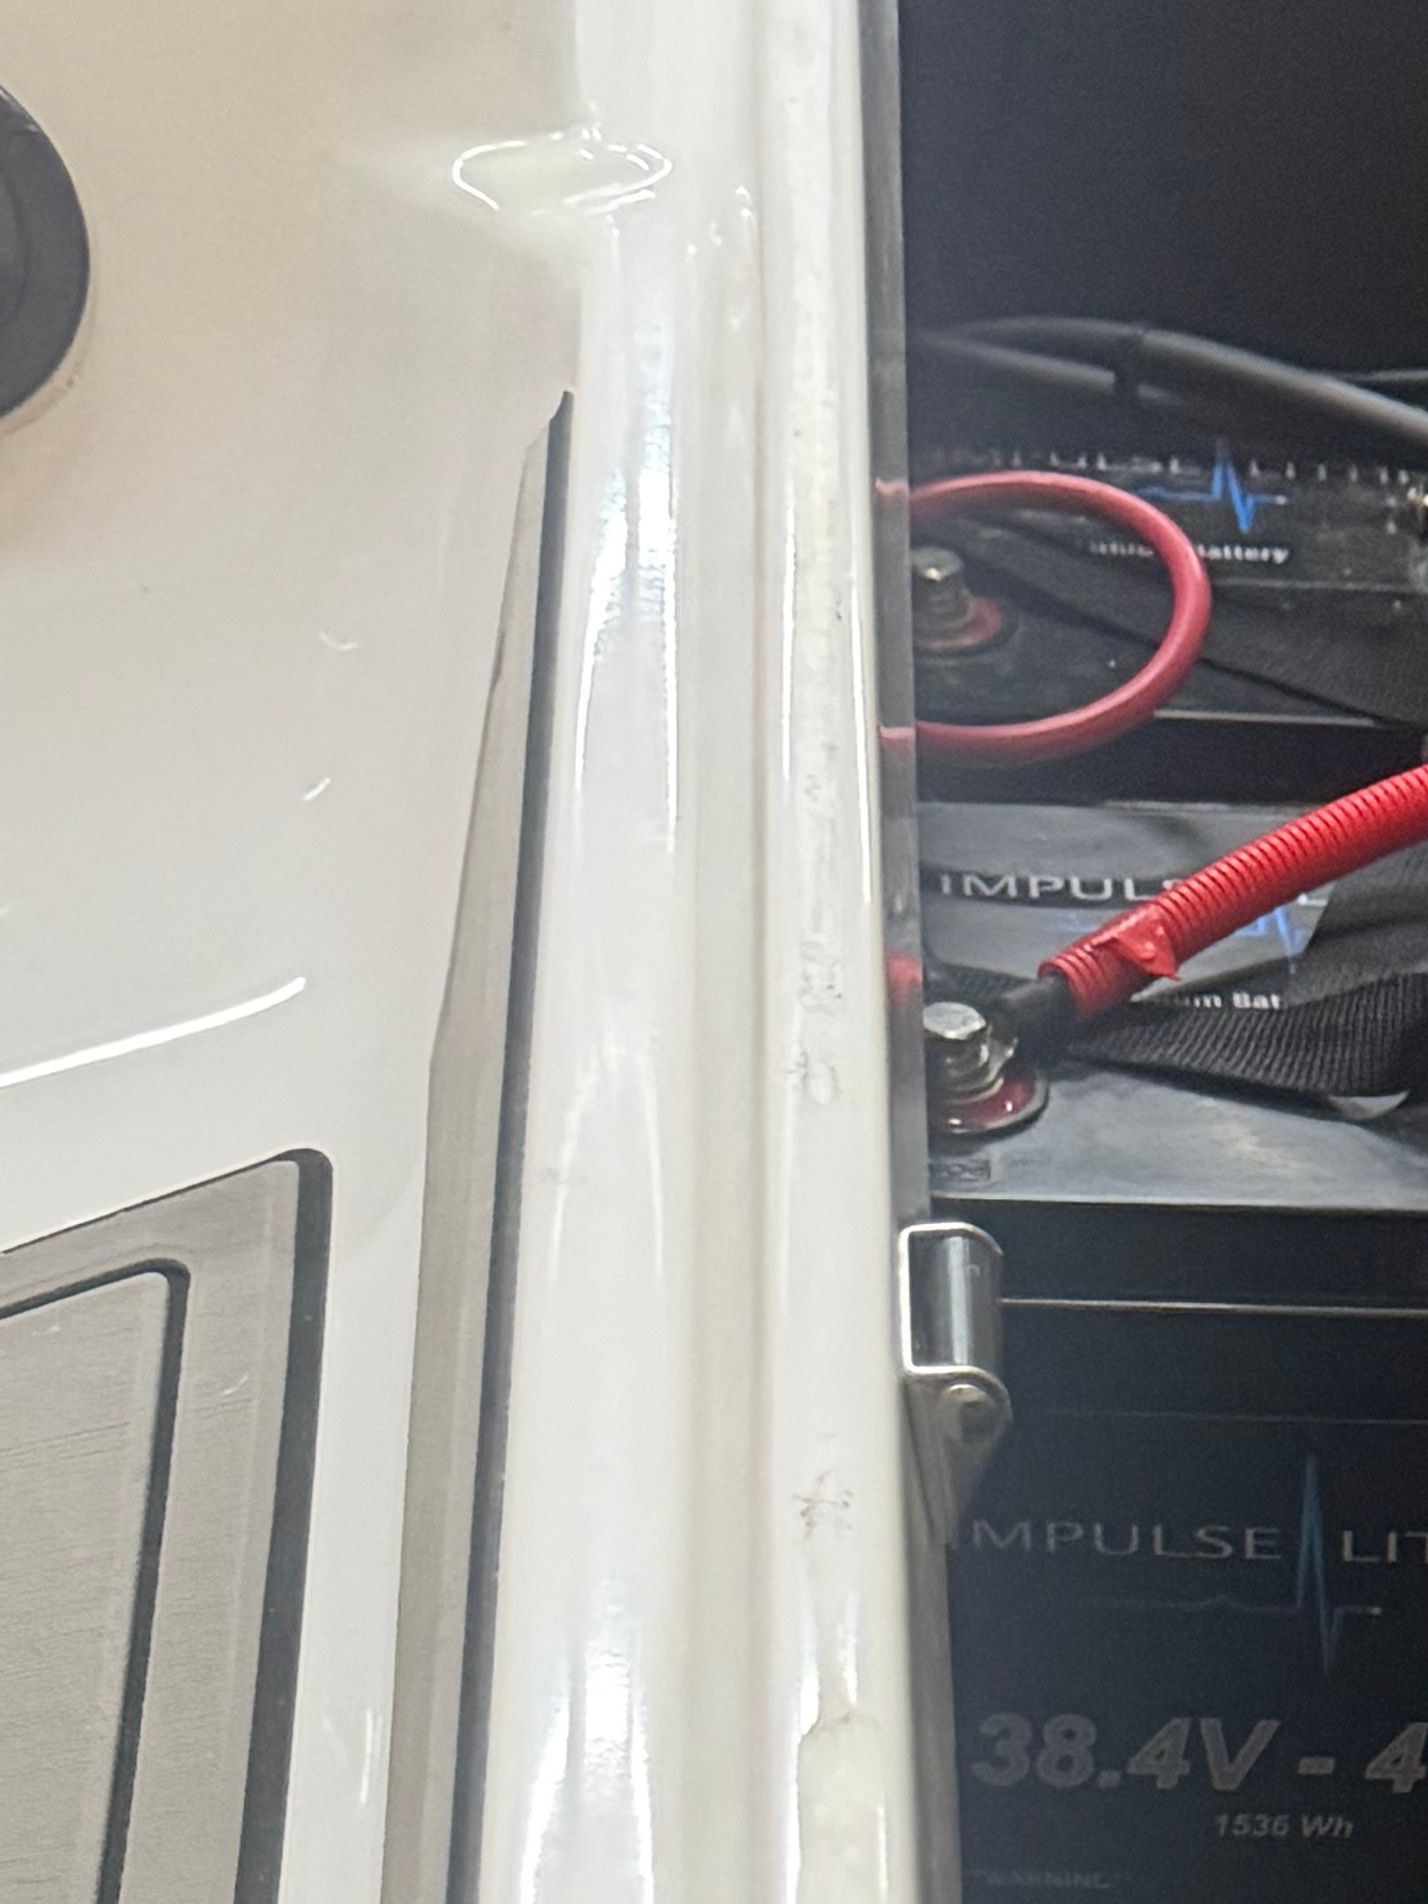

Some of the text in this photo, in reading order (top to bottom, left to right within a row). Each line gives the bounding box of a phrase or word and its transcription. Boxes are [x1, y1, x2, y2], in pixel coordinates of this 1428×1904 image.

[938, 873, 1183, 902] IMPUL
[952, 1518, 1284, 1562] MPULSE
[971, 1711, 1281, 1793] 38.4V
[1215, 1813, 1355, 1840] 1536 Wh
